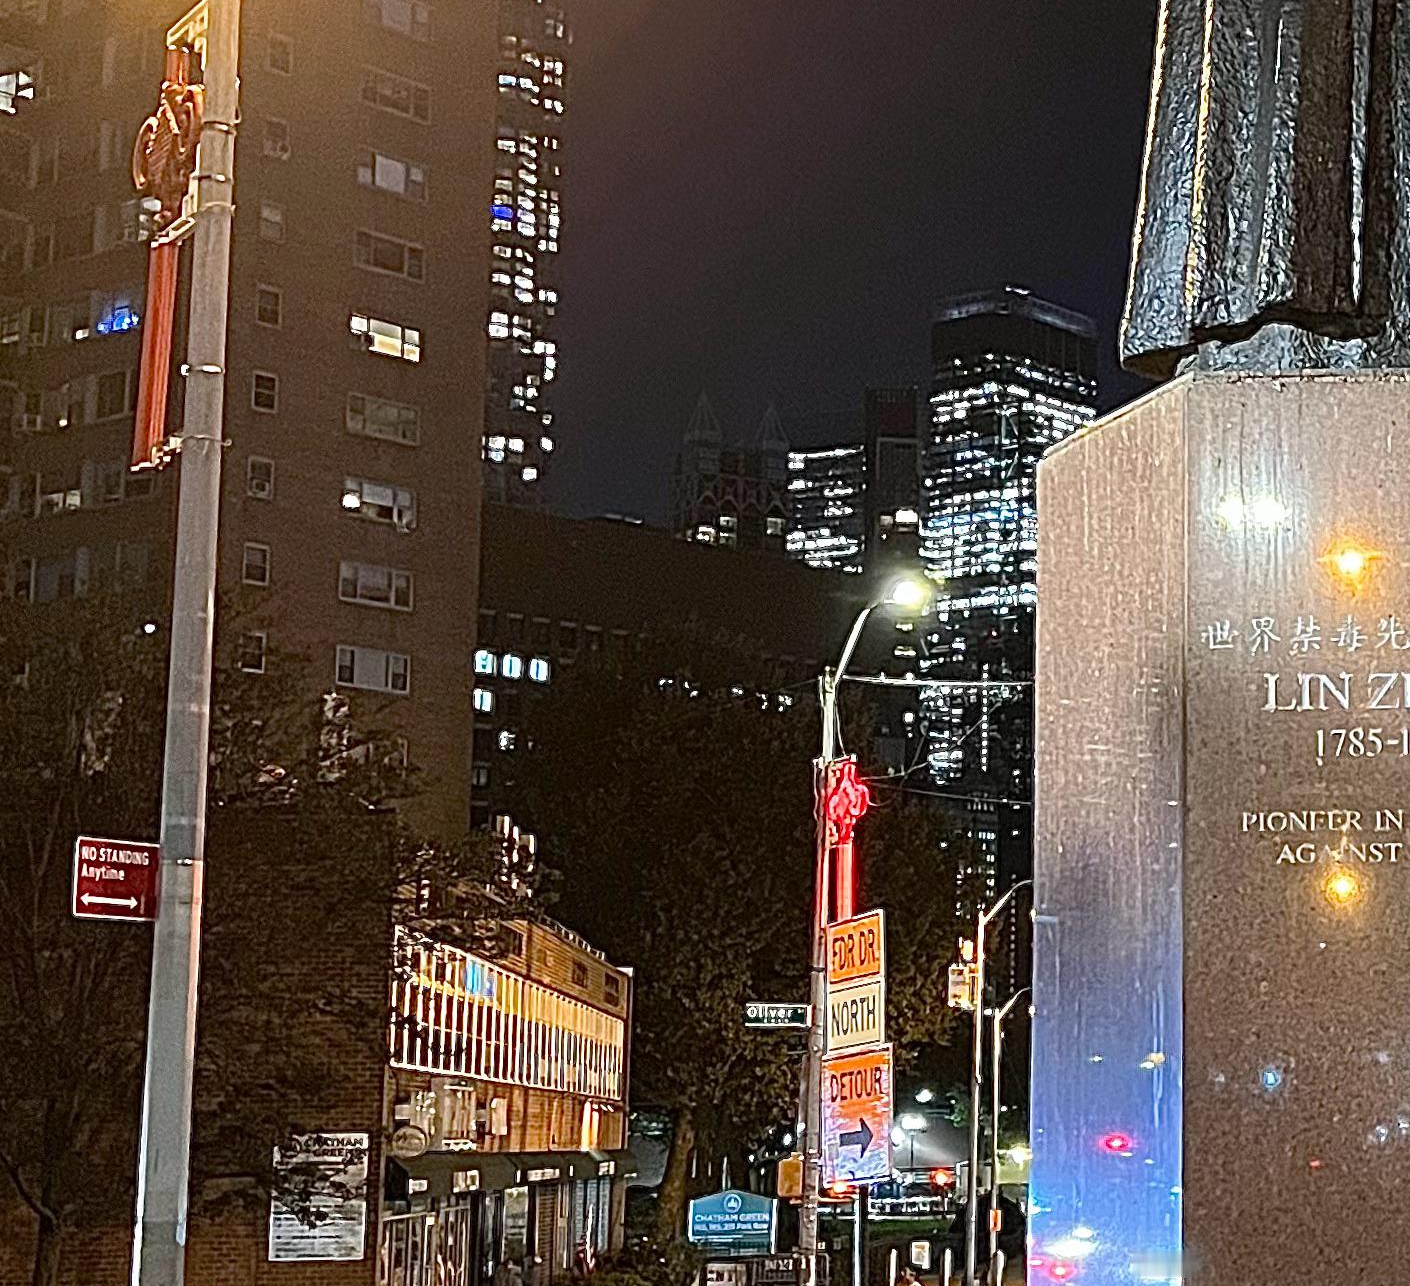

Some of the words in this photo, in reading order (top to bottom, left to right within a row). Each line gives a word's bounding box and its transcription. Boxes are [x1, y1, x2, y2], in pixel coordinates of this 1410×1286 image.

[1260, 671, 1353, 713] LIN
[1241, 809, 1363, 833] PIONEER
[1375, 809, 1404, 832] IN
[81, 845, 98, 861] NO
[99, 847, 149, 866] STANDING
[81, 862, 125, 882] Anytime
[832, 933, 855, 973] FDR
[831, 994, 877, 1038] NORTH
[830, 1066, 883, 1103] DETOUR
